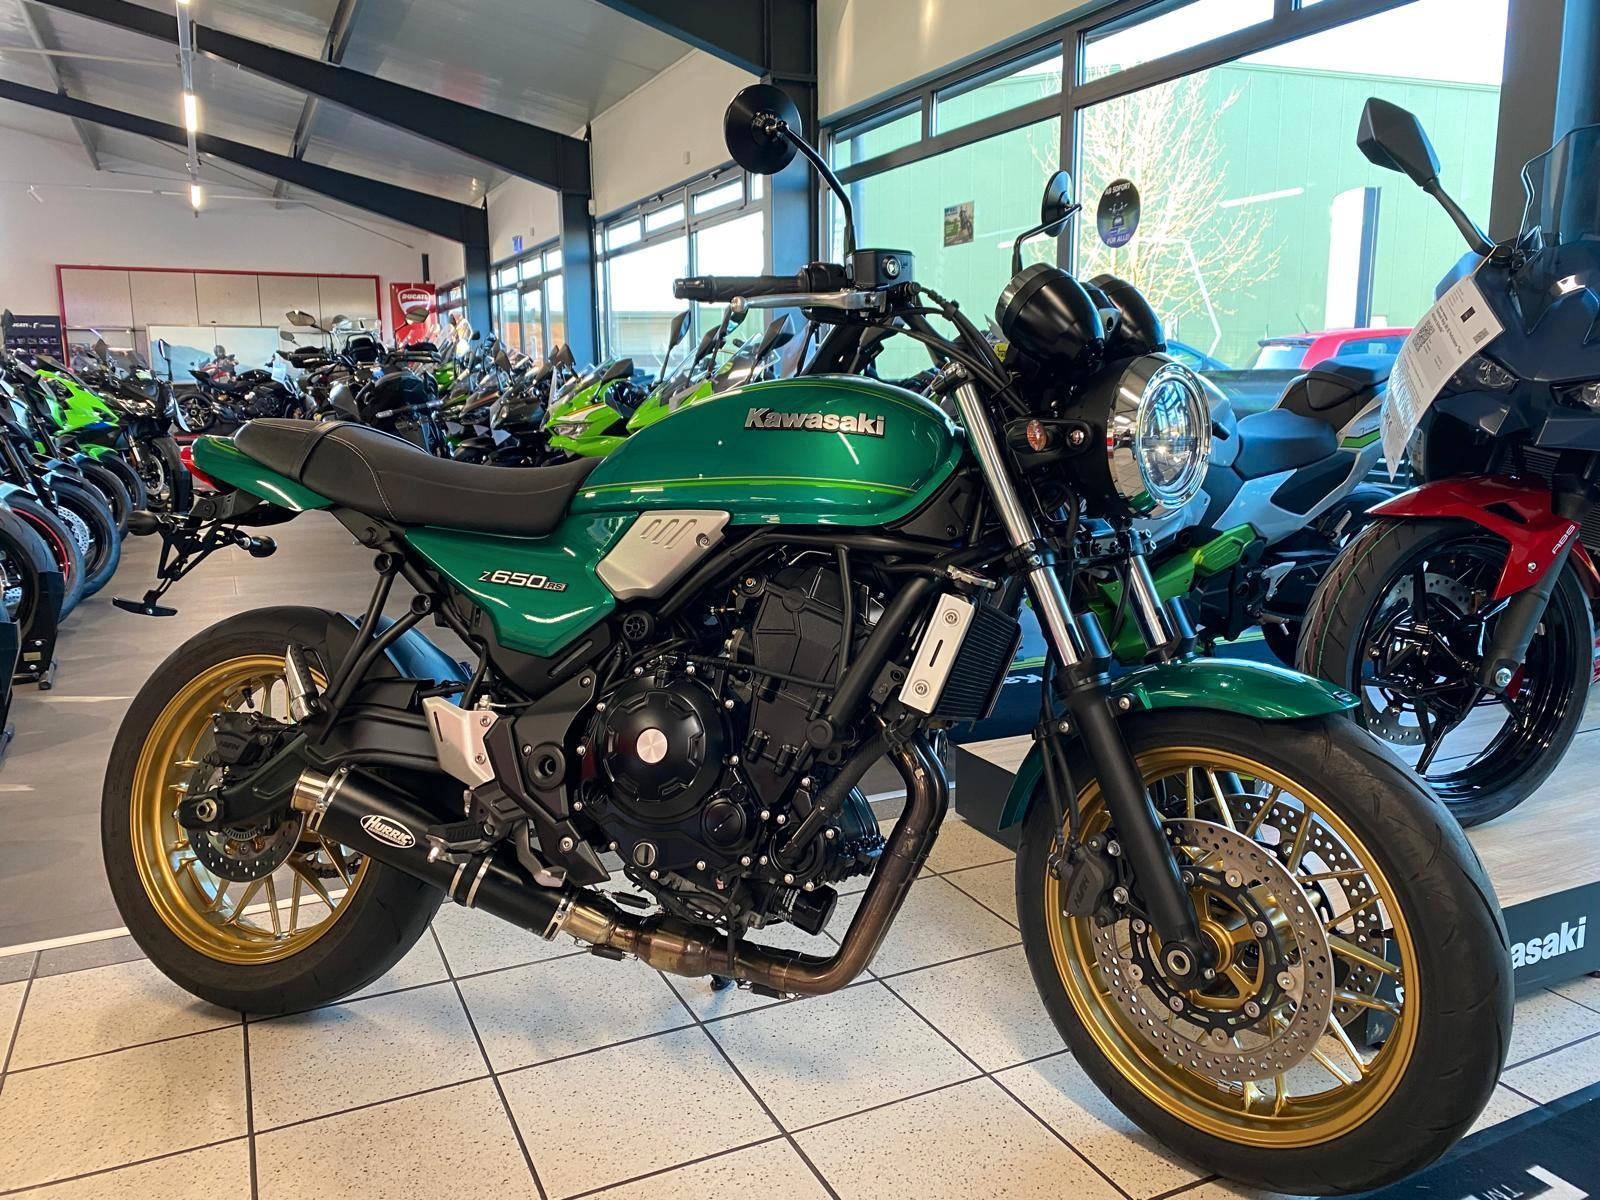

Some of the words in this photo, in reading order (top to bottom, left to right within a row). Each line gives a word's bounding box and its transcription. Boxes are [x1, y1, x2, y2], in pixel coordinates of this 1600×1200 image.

[744, 407, 885, 436] Kawasaki
[1552, 524, 1576, 554] ABS
[1511, 915, 1588, 970] asaki
